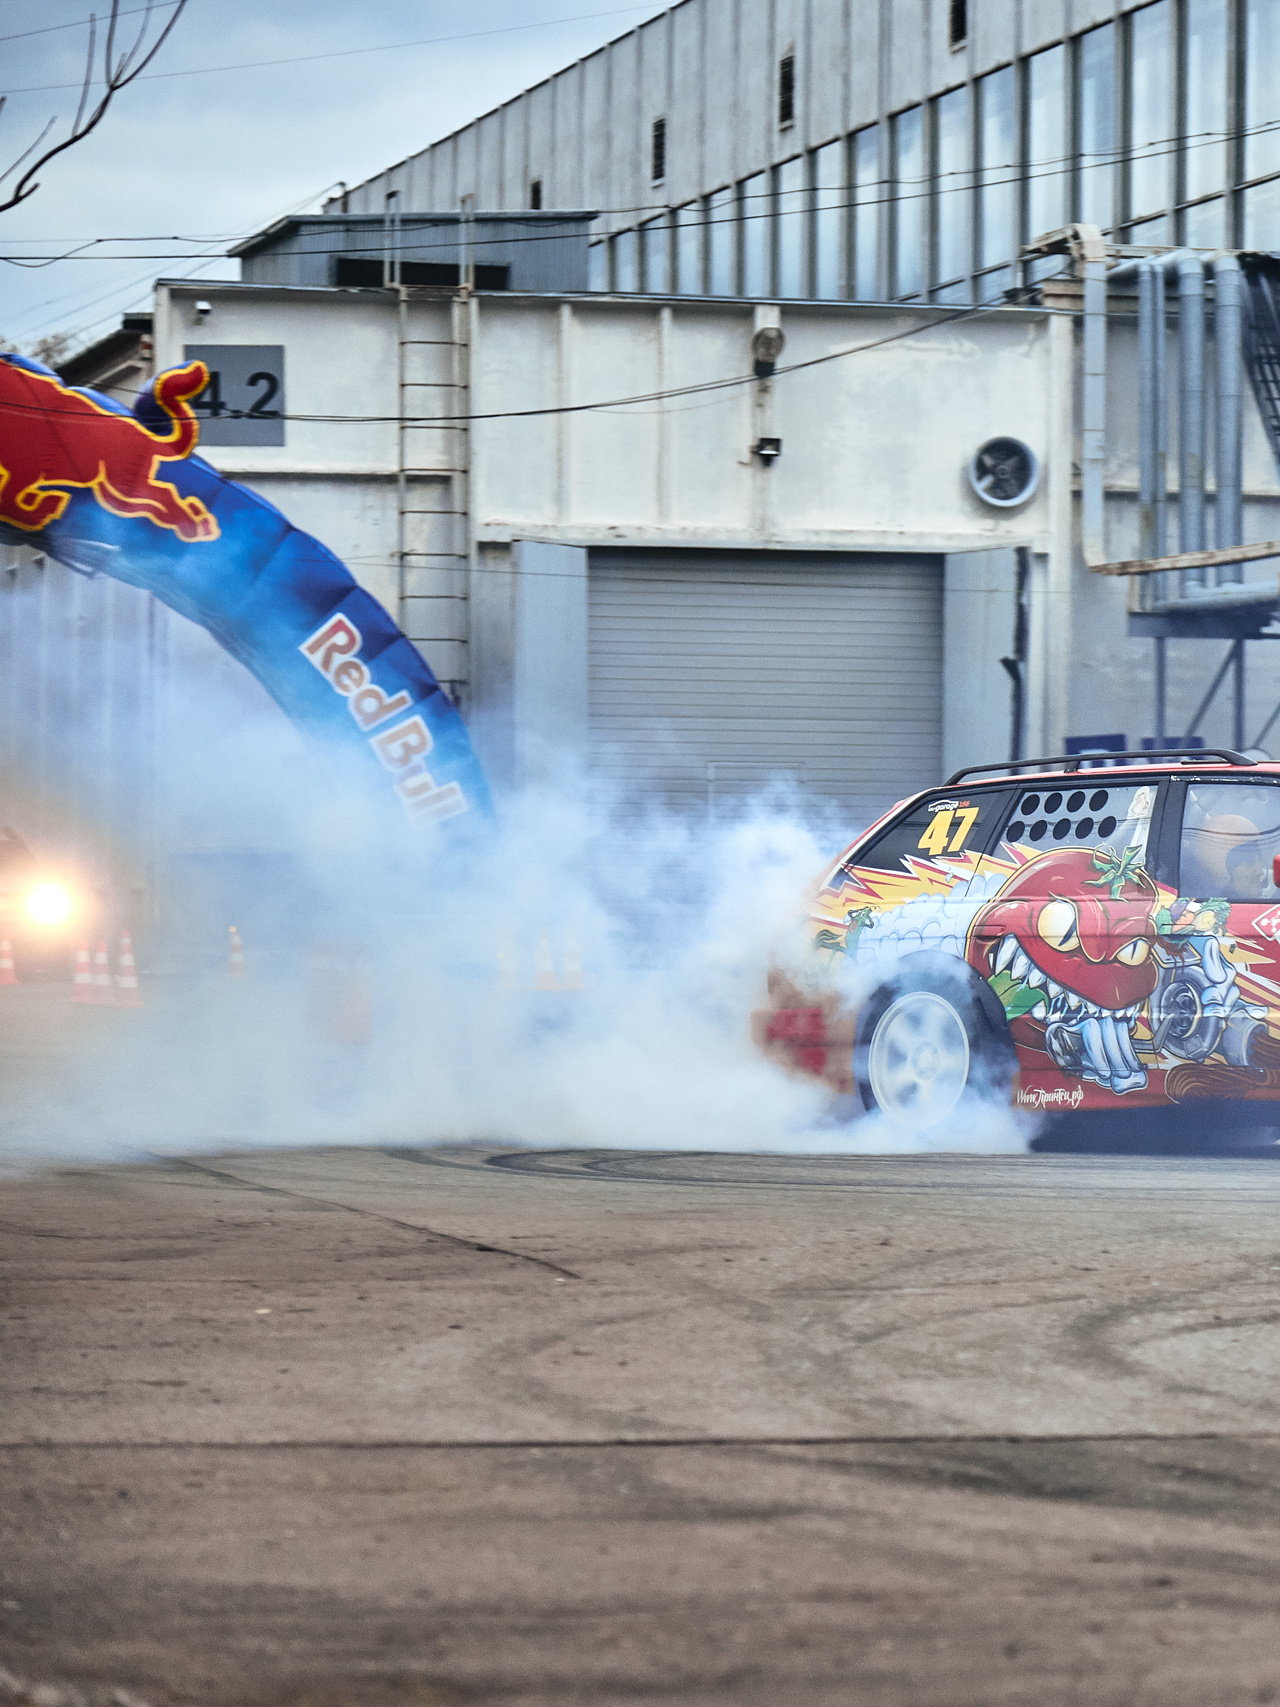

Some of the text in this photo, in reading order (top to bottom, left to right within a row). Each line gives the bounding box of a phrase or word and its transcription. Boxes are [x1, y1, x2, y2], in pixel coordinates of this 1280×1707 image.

[299, 612, 469, 824] Red Bull
[917, 806, 979, 856] 47
